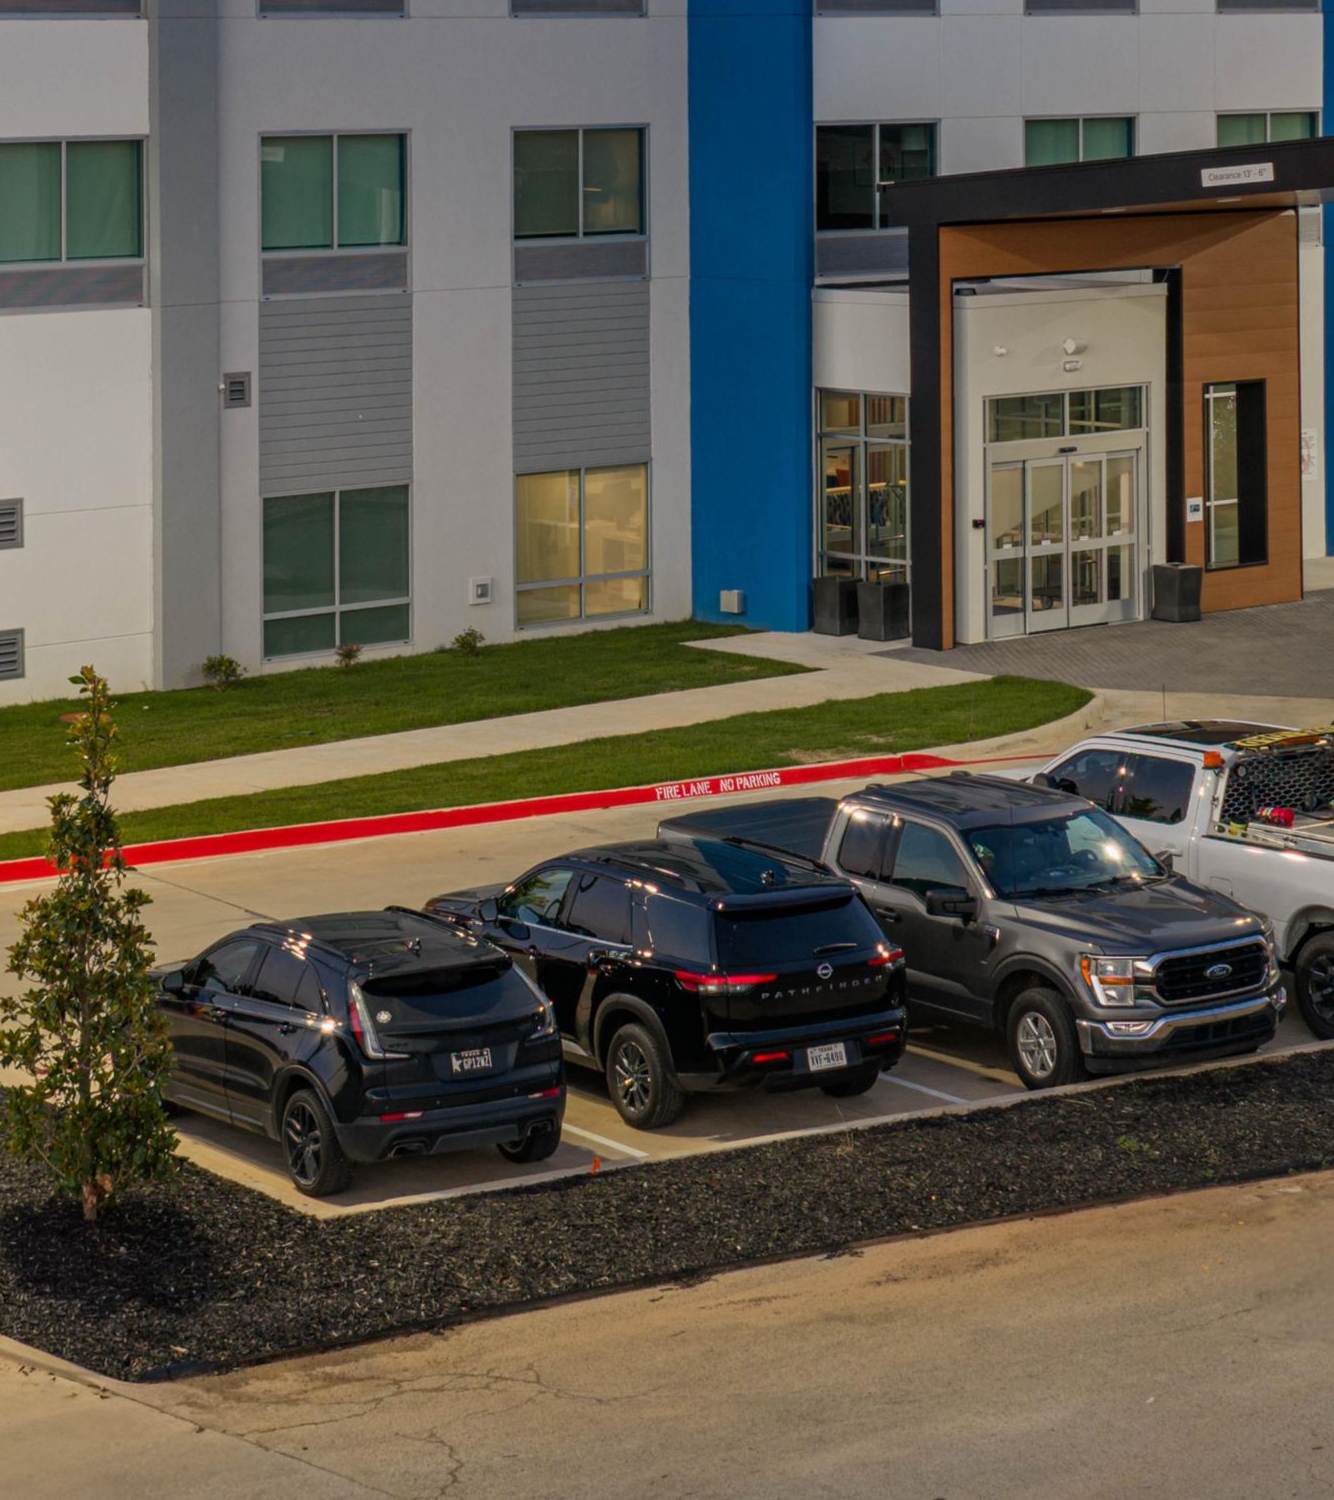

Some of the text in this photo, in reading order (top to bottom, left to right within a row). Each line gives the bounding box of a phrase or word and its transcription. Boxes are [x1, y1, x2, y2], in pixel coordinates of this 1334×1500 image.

[1208, 172, 1241, 181] Clearance
[655, 772, 781, 800] FIRE LANE NO PARKING
[761, 974, 883, 1000] PATHFINDER
